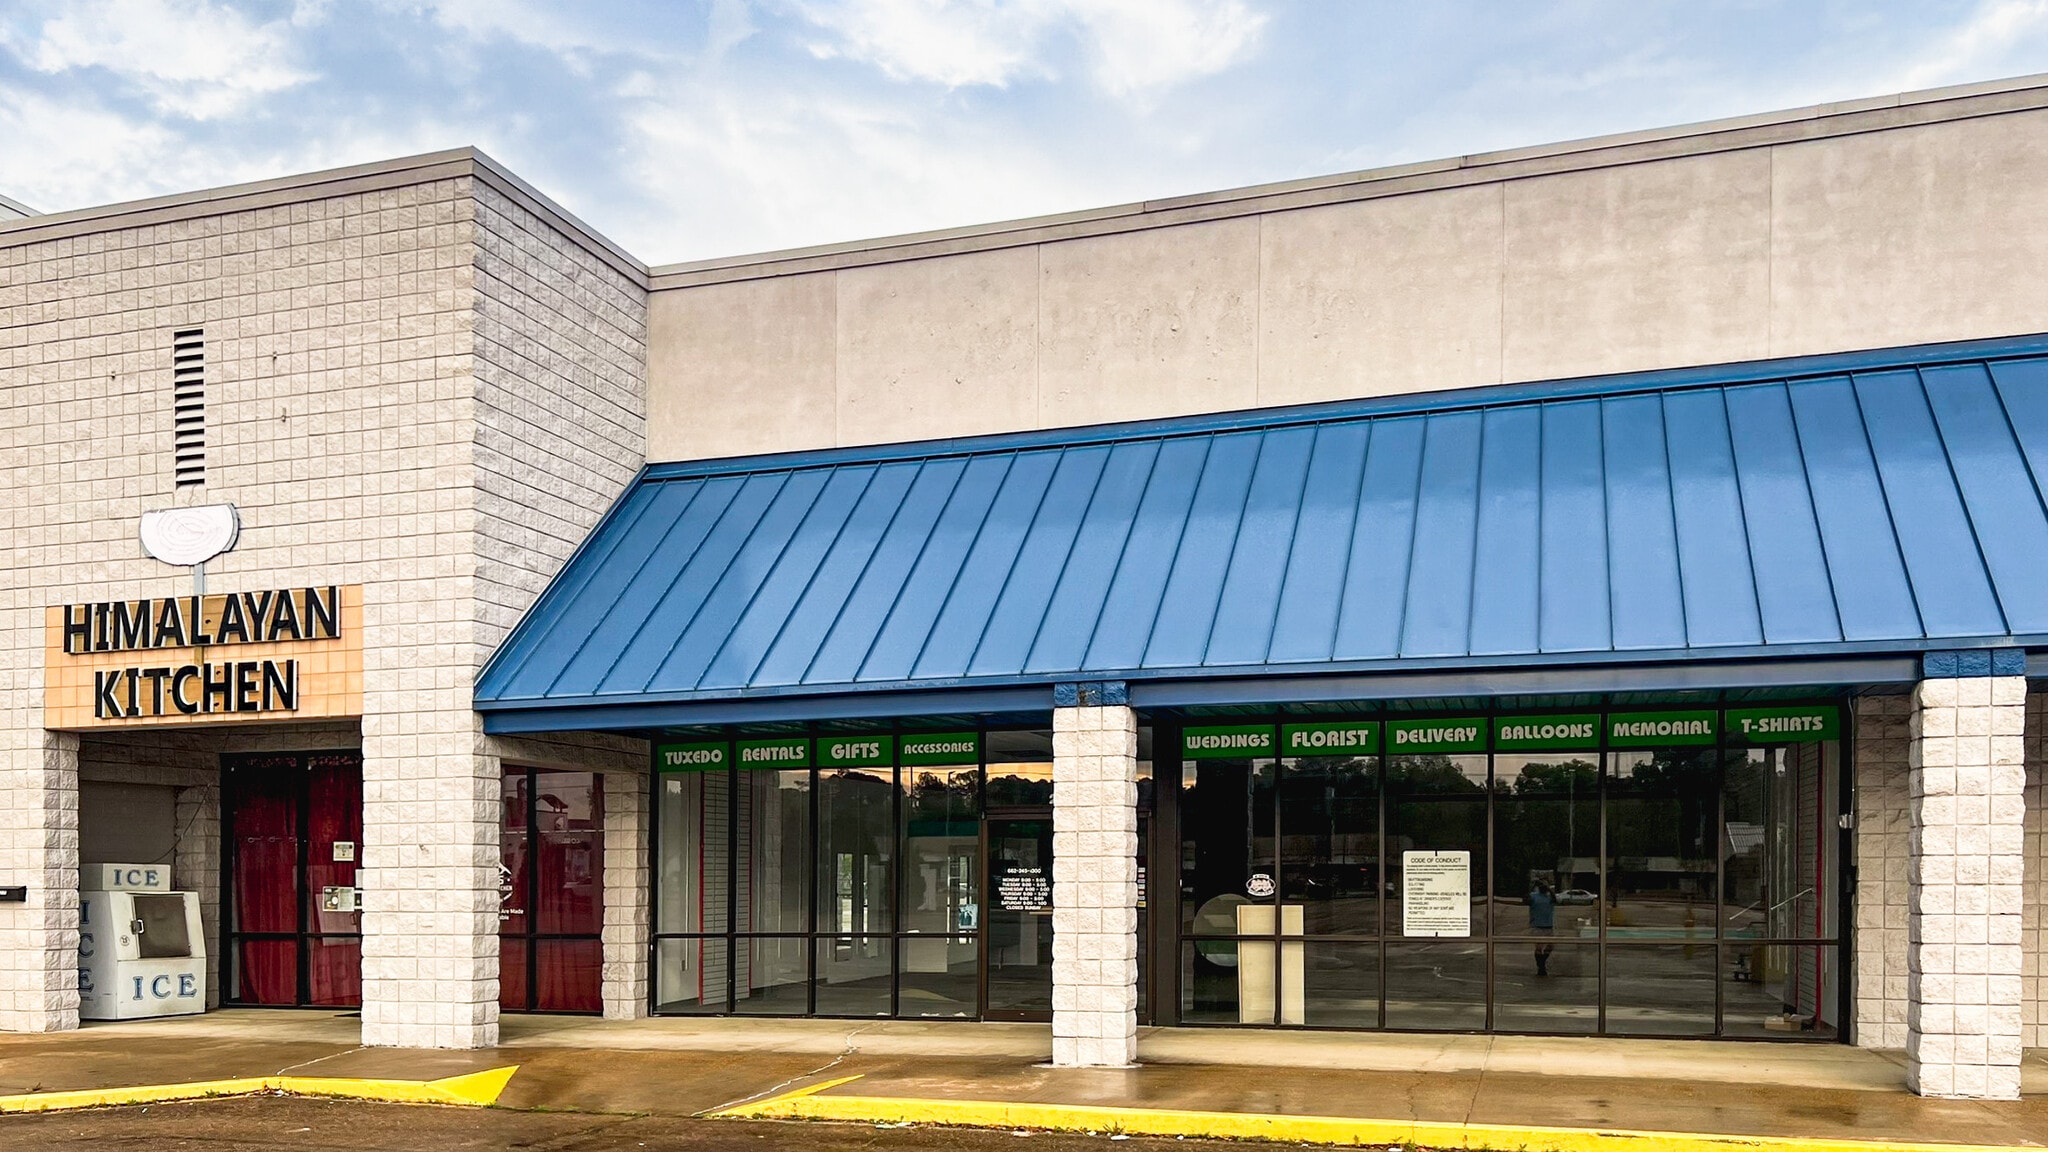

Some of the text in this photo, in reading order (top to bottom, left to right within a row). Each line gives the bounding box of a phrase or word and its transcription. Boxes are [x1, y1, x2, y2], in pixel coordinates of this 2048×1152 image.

[63, 586, 341, 653] HIMALAYAN
[94, 660, 299, 718] KITCHEN
[1501, 723, 1593, 740] BALLOONS
[1613, 720, 1711, 737] MEMORIAL
[1741, 716, 1824, 733] T-SHIRTS
[1186, 733, 1270, 749] WEDDINGS
[1291, 729, 1369, 748] FLORIST
[1396, 727, 1477, 744] DELIVERY
[742, 745, 805, 762] RENTALS
[831, 742, 880, 759] GIFTS
[904, 741, 974, 754] ACCESSORIES
[665, 749, 723, 765] TUXEDO
[113, 869, 160, 887] ICE
[132, 973, 198, 1000] ICE
